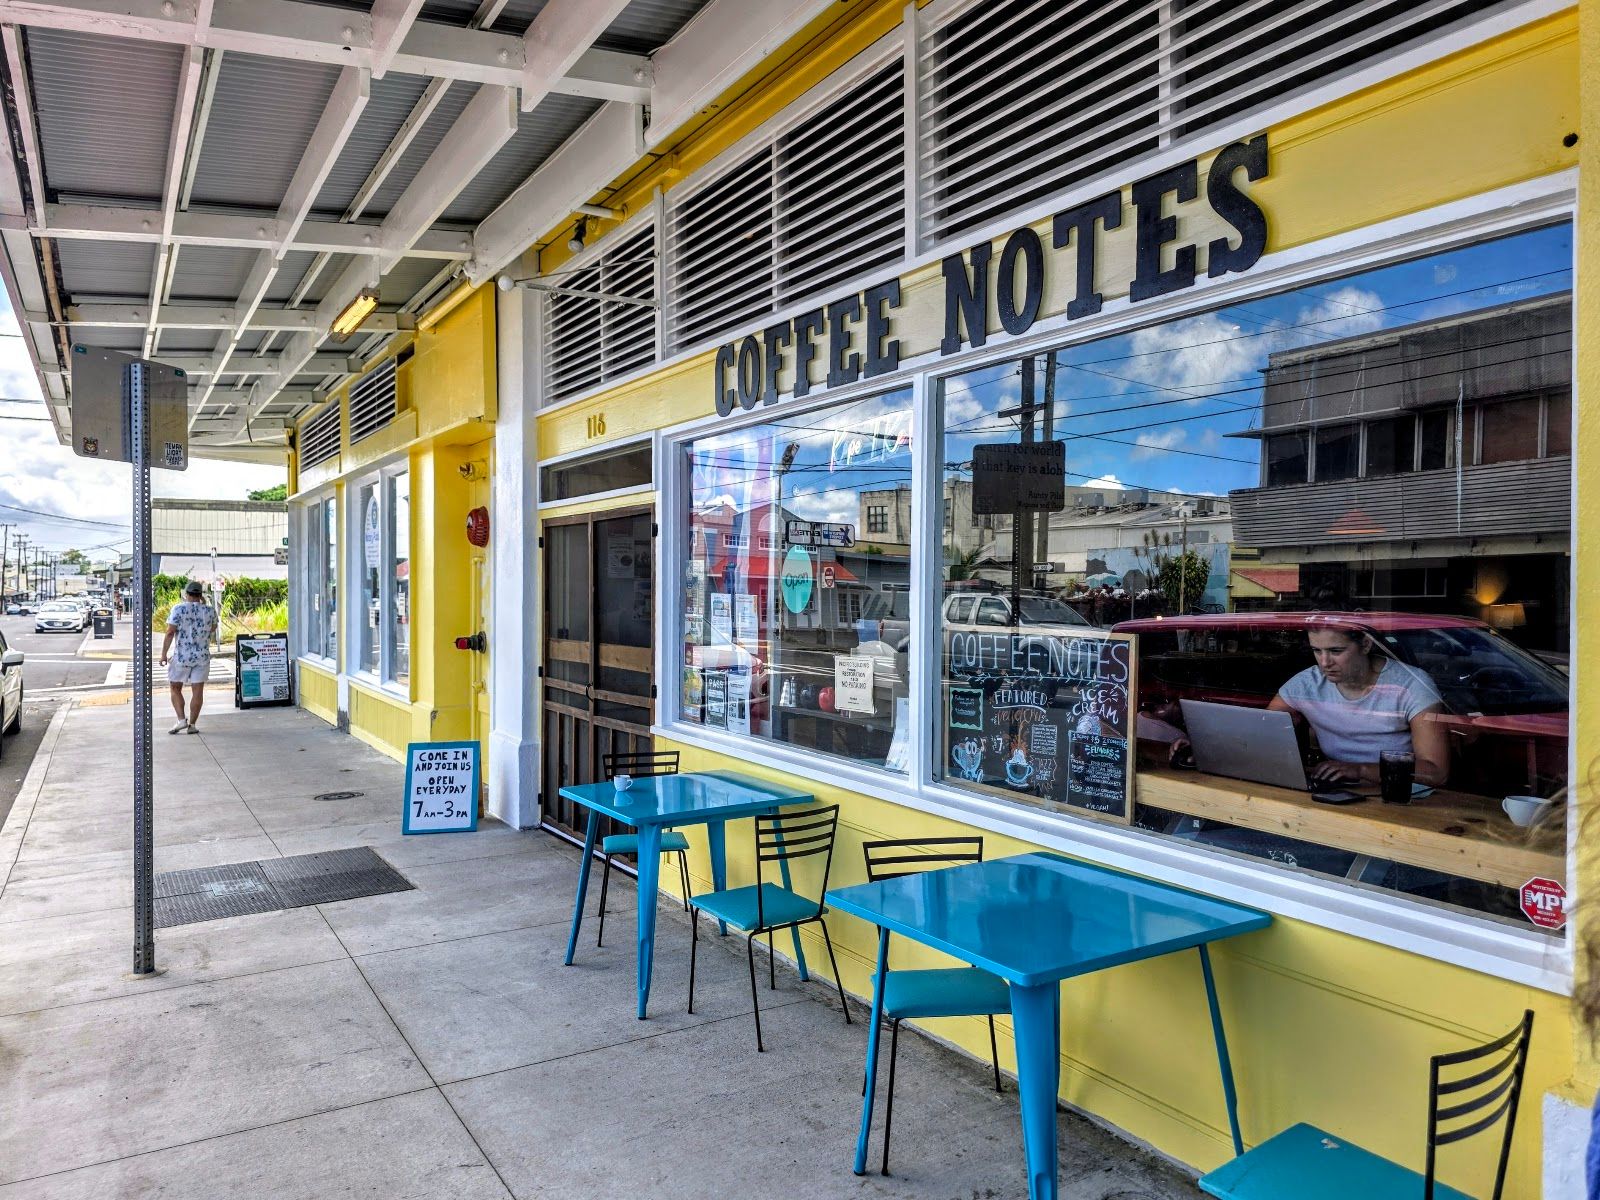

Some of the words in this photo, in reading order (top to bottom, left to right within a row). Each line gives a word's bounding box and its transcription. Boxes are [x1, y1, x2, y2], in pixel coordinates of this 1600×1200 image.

[715, 277, 900, 418] COFFEE
[941, 133, 1269, 356] NOTES
[1006, 459, 1026, 475] key
[1028, 462, 1038, 474] is
[785, 572, 809, 591] Open
[951, 633, 1043, 673] COFFEE
[1047, 637, 1130, 683] NOTES
[994, 689, 1048, 706] FEATURED
[1078, 688, 1112, 704] ICE
[1072, 701, 1119, 725] CREAM
[419, 751, 448, 762] COME
[453, 751, 468, 760] IN
[415, 762, 433, 772] AND
[434, 762, 458, 771] JOIN
[460, 762, 471, 771] US
[428, 775, 455, 785] OPEN
[416, 785, 467, 795] EVERYDAY
